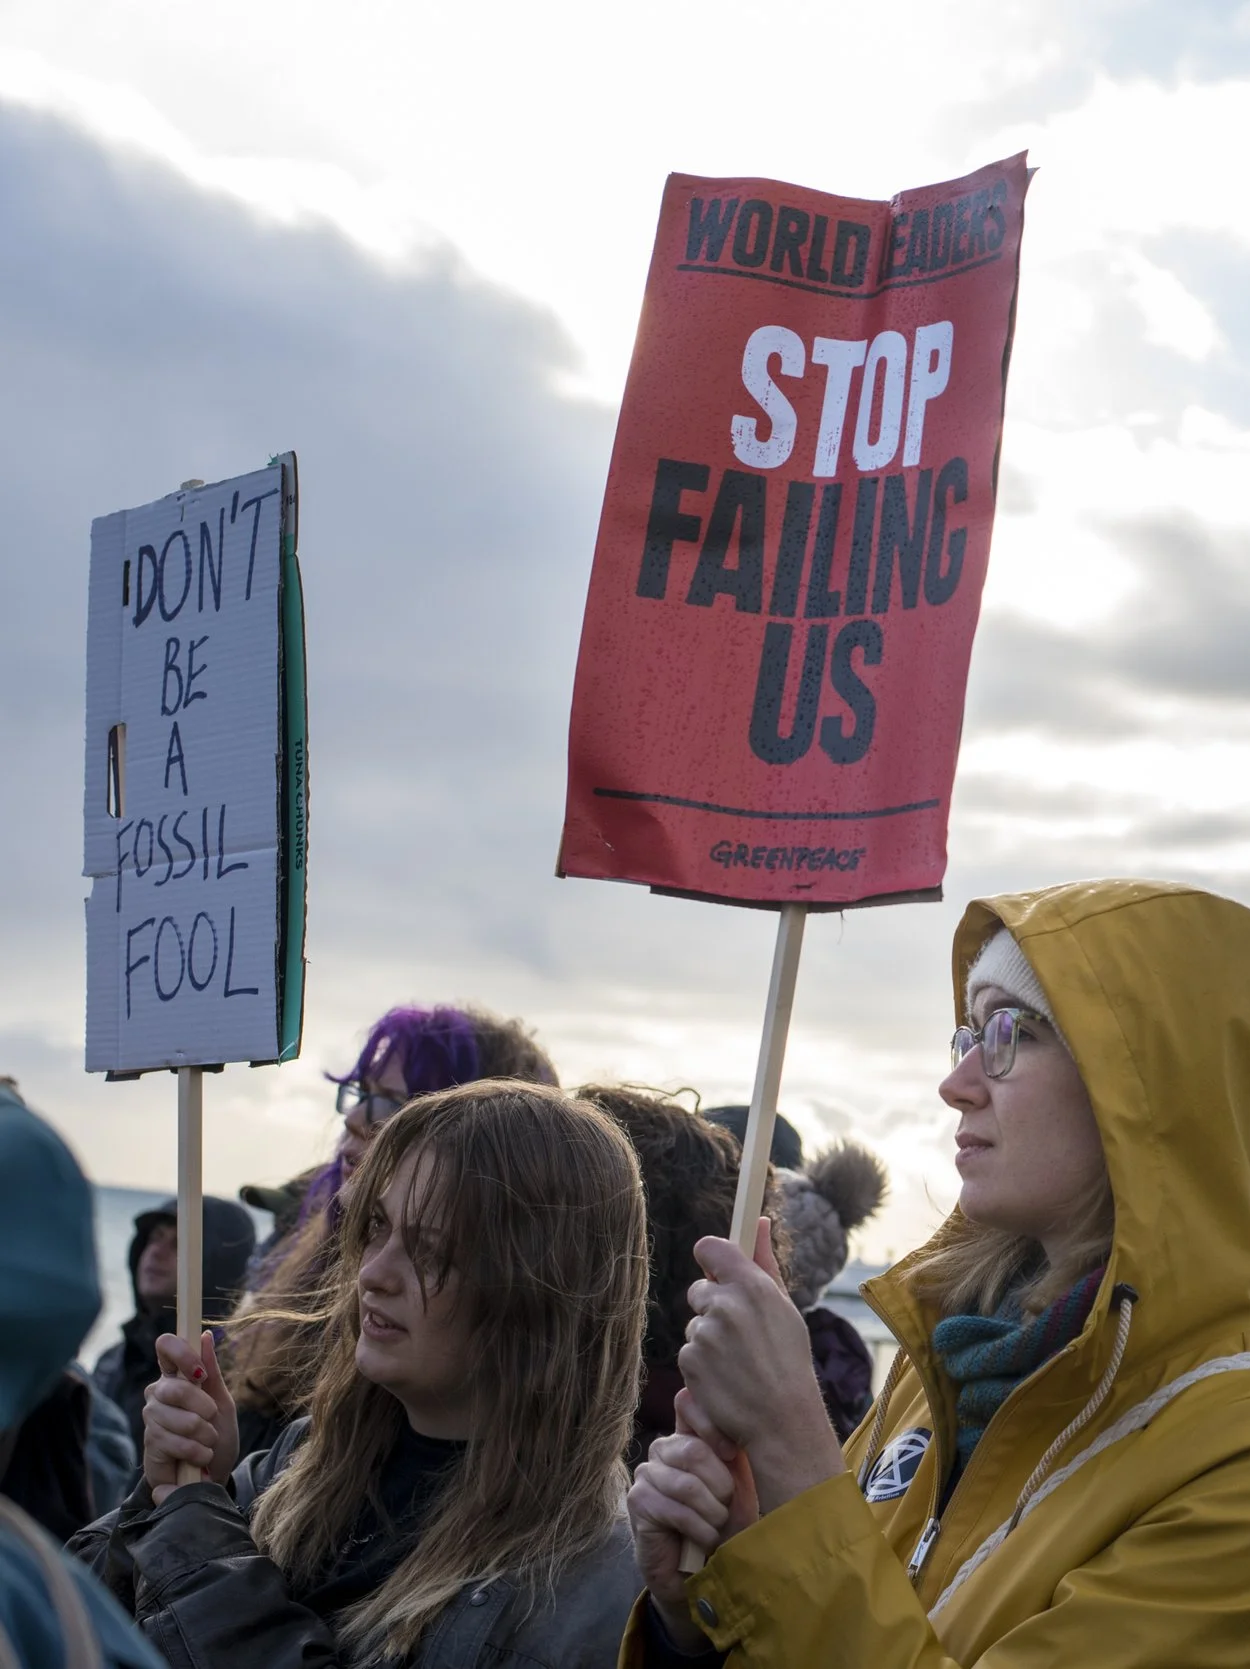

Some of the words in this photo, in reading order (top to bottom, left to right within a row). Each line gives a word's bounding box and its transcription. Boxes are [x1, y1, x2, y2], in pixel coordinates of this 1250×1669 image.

[685, 197, 872, 288] WORLD
[877, 180, 1008, 282] EADERS
[730, 320, 954, 477] STOP
[132, 487, 280, 629] DON'T
[635, 456, 969, 618] FAILING
[160, 635, 210, 717] BE
[748, 619, 885, 766] US
[164, 721, 189, 796] A
[295, 738, 303, 789] TUNA
[116, 804, 249, 913] FOSSIL
[295, 792, 303, 870] CHUNKS
[709, 839, 868, 872] GREENPEACE
[125, 906, 259, 1021] FOOL
